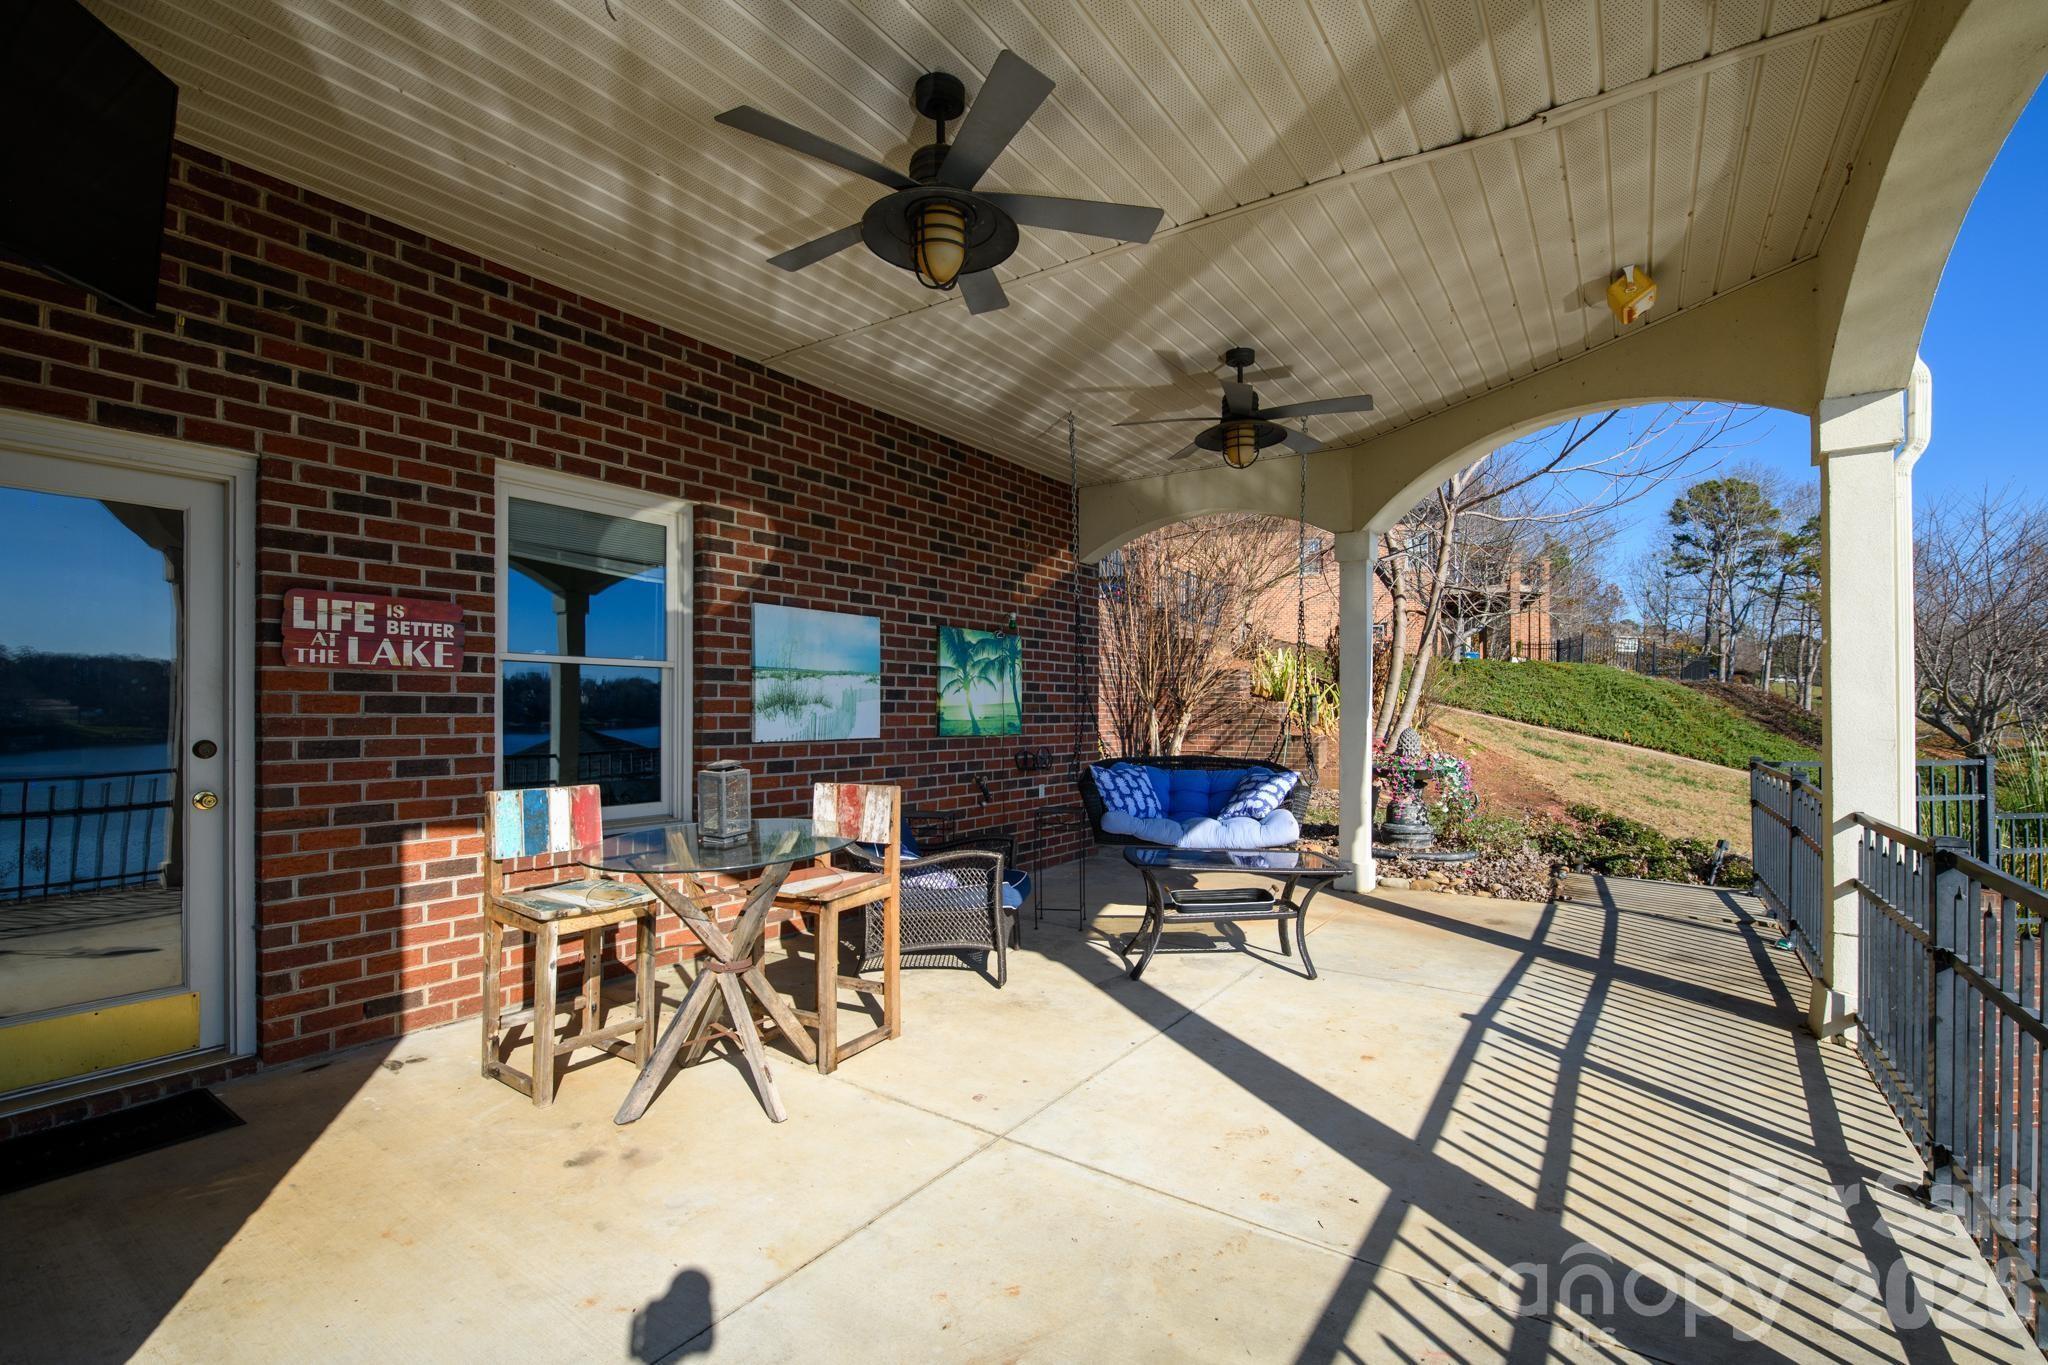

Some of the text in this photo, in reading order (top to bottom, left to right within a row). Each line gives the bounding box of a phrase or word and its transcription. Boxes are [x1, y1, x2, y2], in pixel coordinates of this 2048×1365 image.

[293, 596, 405, 633] LIFE IS
[386, 620, 455, 638] BETTER
[310, 631, 340, 647] AT
[293, 647, 340, 664] THE
[347, 636, 455, 668] LAKE
